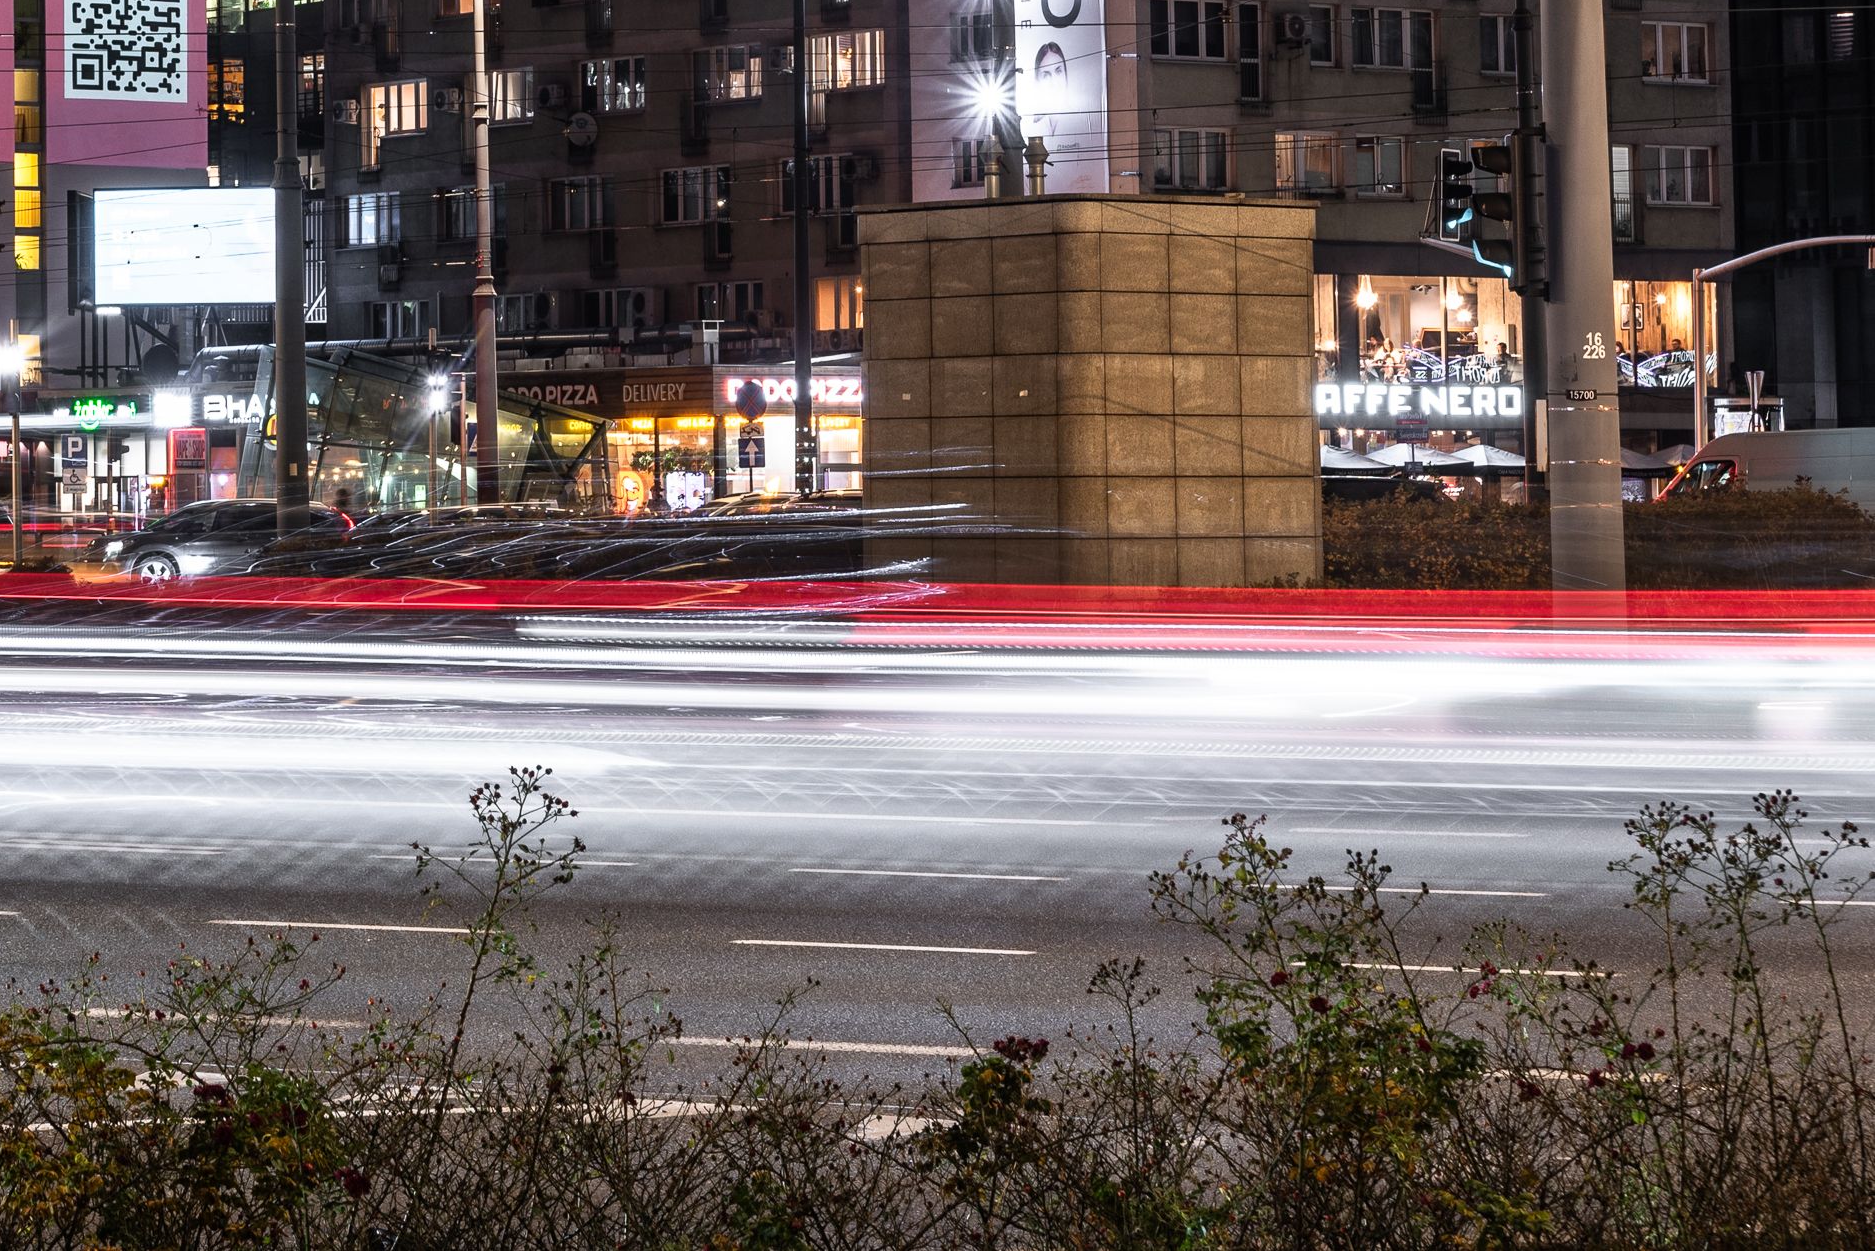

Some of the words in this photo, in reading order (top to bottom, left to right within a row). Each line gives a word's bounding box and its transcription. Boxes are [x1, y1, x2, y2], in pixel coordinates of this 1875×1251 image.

[1586, 332, 1603, 346] 16
[1582, 345, 1606, 359] 226
[546, 384, 598, 405] PIZZA
[623, 382, 687, 403] DELIVERY
[727, 378, 797, 403] DDO
[1420, 386, 1521, 416] NERO
[1569, 390, 1595, 400] 15700
[67, 436, 83, 458] P
